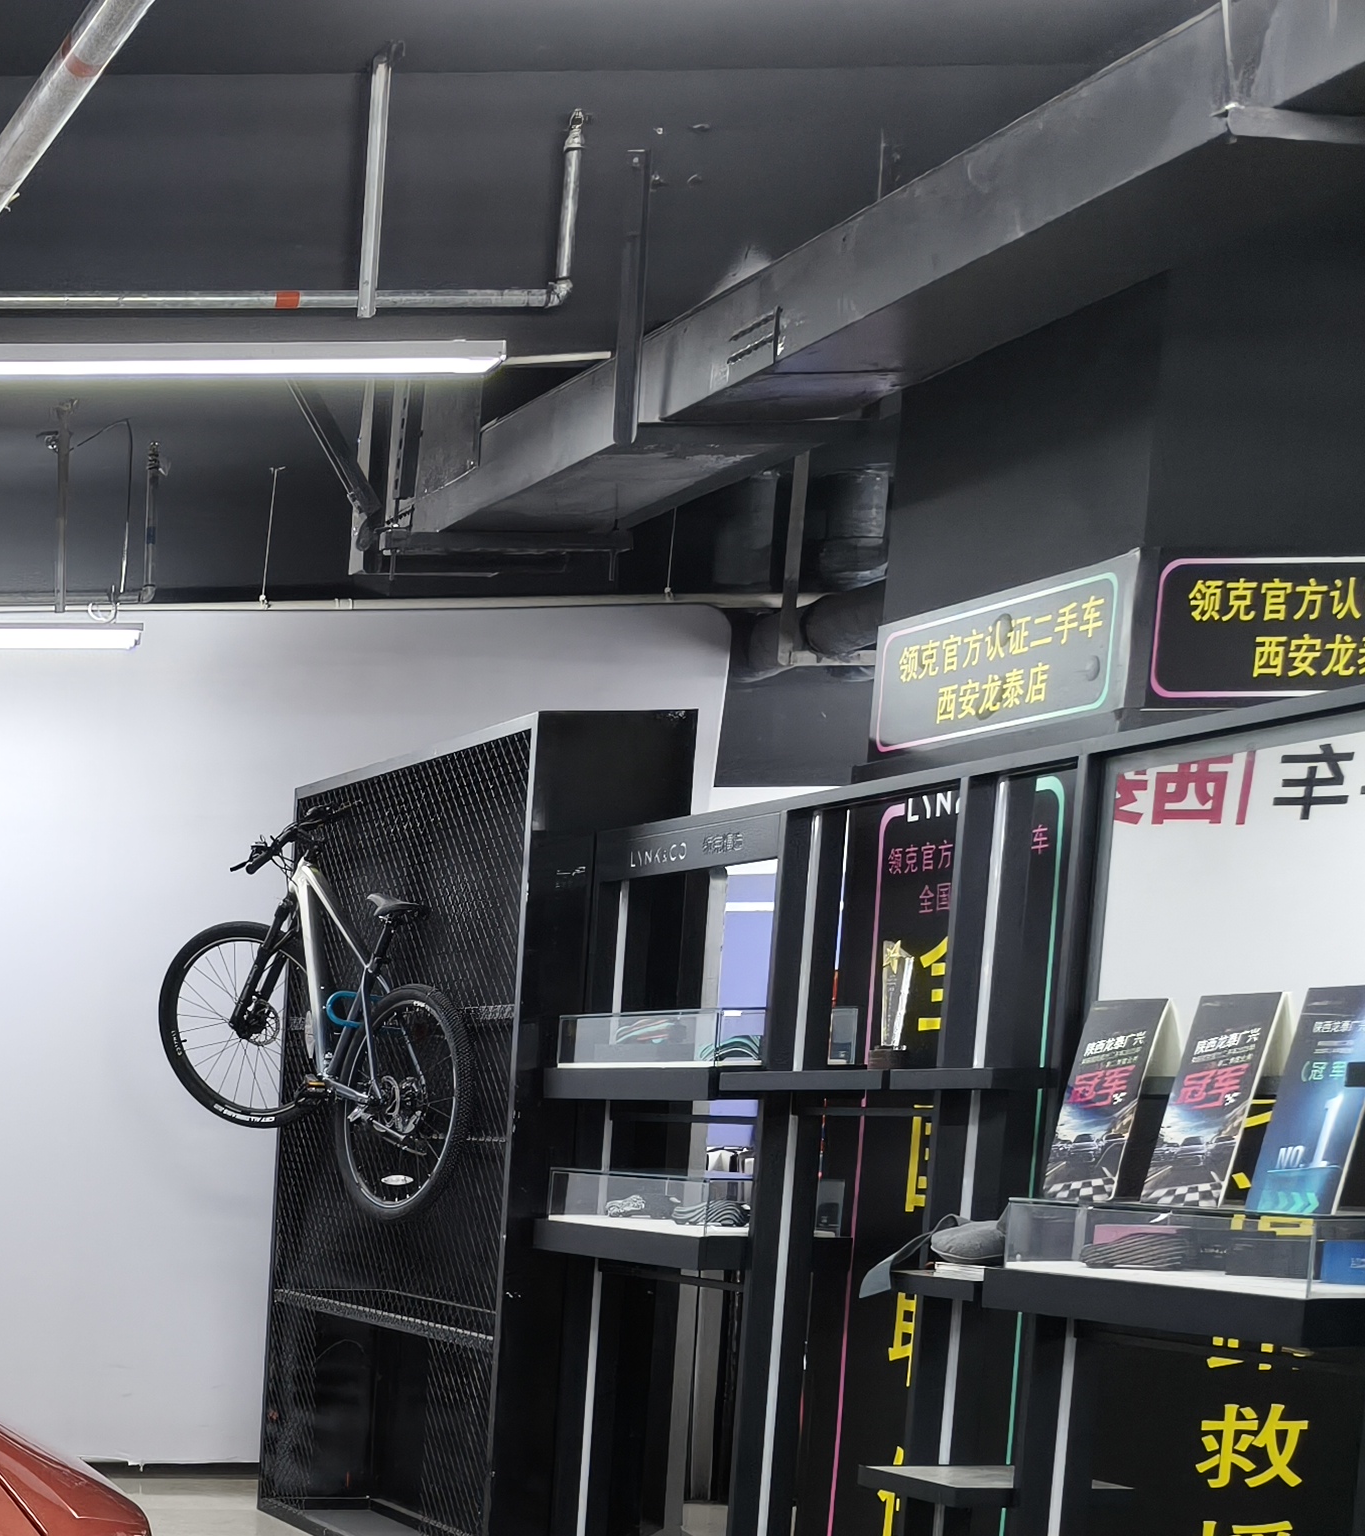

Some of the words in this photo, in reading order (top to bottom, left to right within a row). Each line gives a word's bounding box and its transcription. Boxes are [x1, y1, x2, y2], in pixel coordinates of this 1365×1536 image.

[1188, 577, 1362, 623] 领克官方认
[899, 596, 1106, 684] 领克官方认证二手车
[1252, 635, 1365, 678] 西安龙
[935, 663, 1051, 725] 西安龙泰店
[907, 791, 961, 823] LYN
[888, 840, 954, 875] 领克官方
[1031, 824, 1049, 855] 车
